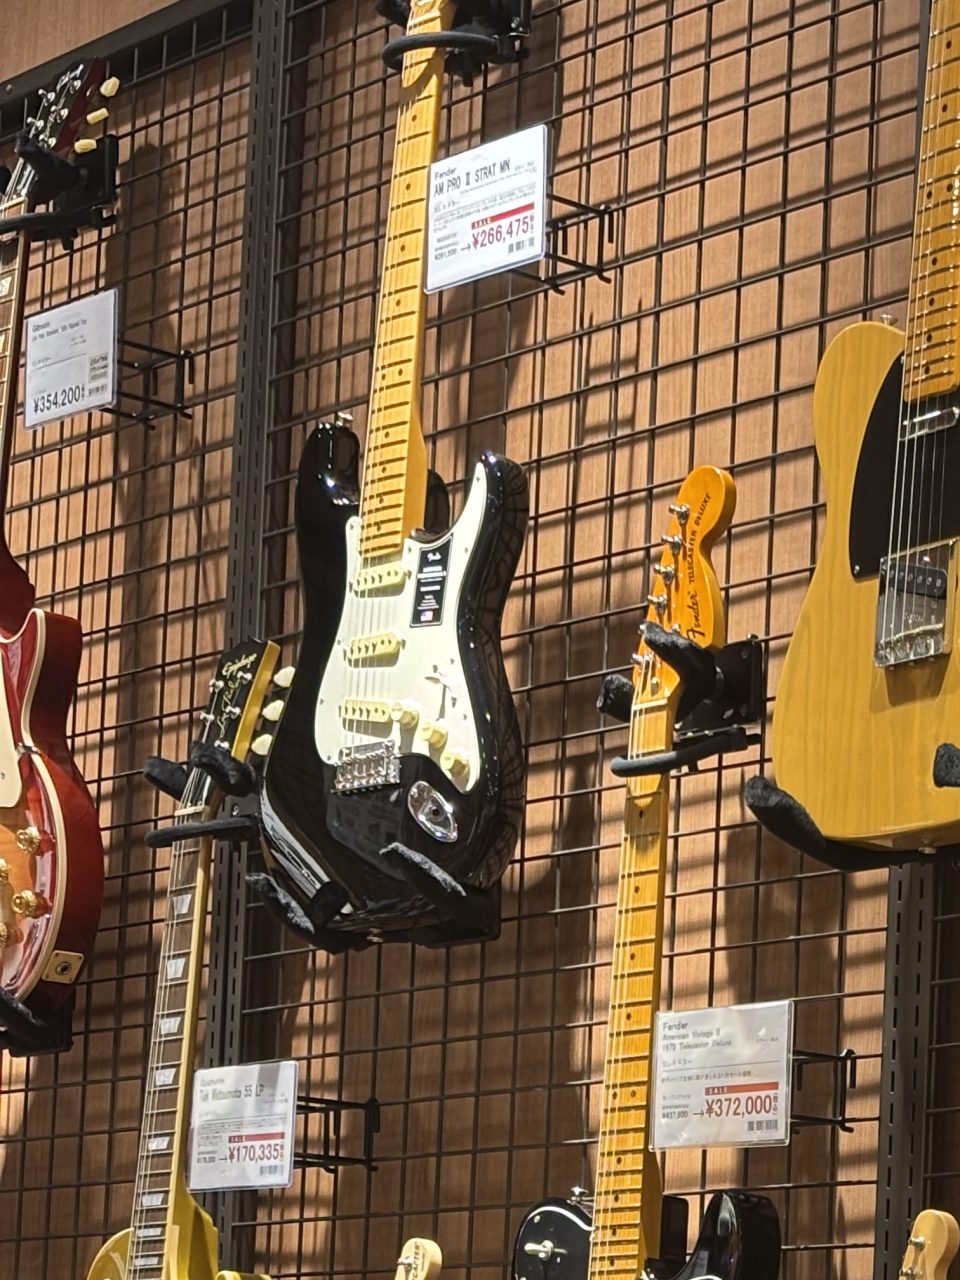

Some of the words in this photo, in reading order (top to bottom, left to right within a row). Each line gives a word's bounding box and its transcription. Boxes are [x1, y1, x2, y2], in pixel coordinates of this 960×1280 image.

[434, 182, 444, 197] AM
[447, 177, 461, 194] PRO
[475, 164, 496, 183] STRAT
[500, 158, 510, 172] MN
[472, 216, 529, 250] ¥266,475
[34, 385, 80, 414] ¥354,200
[694, 493, 711, 526] DELUXE
[688, 530, 697, 583] TELECASTER
[686, 591, 705, 642] Fender
[222, 653, 257, 679] Epiphone
[663, 1022, 688, 1031] Fender
[255, 1084, 264, 1097] LP
[709, 1087, 728, 1095] SALE
[706, 1094, 772, 1119] ¥372,000
[229, 1144, 280, 1164] ¥170,335
